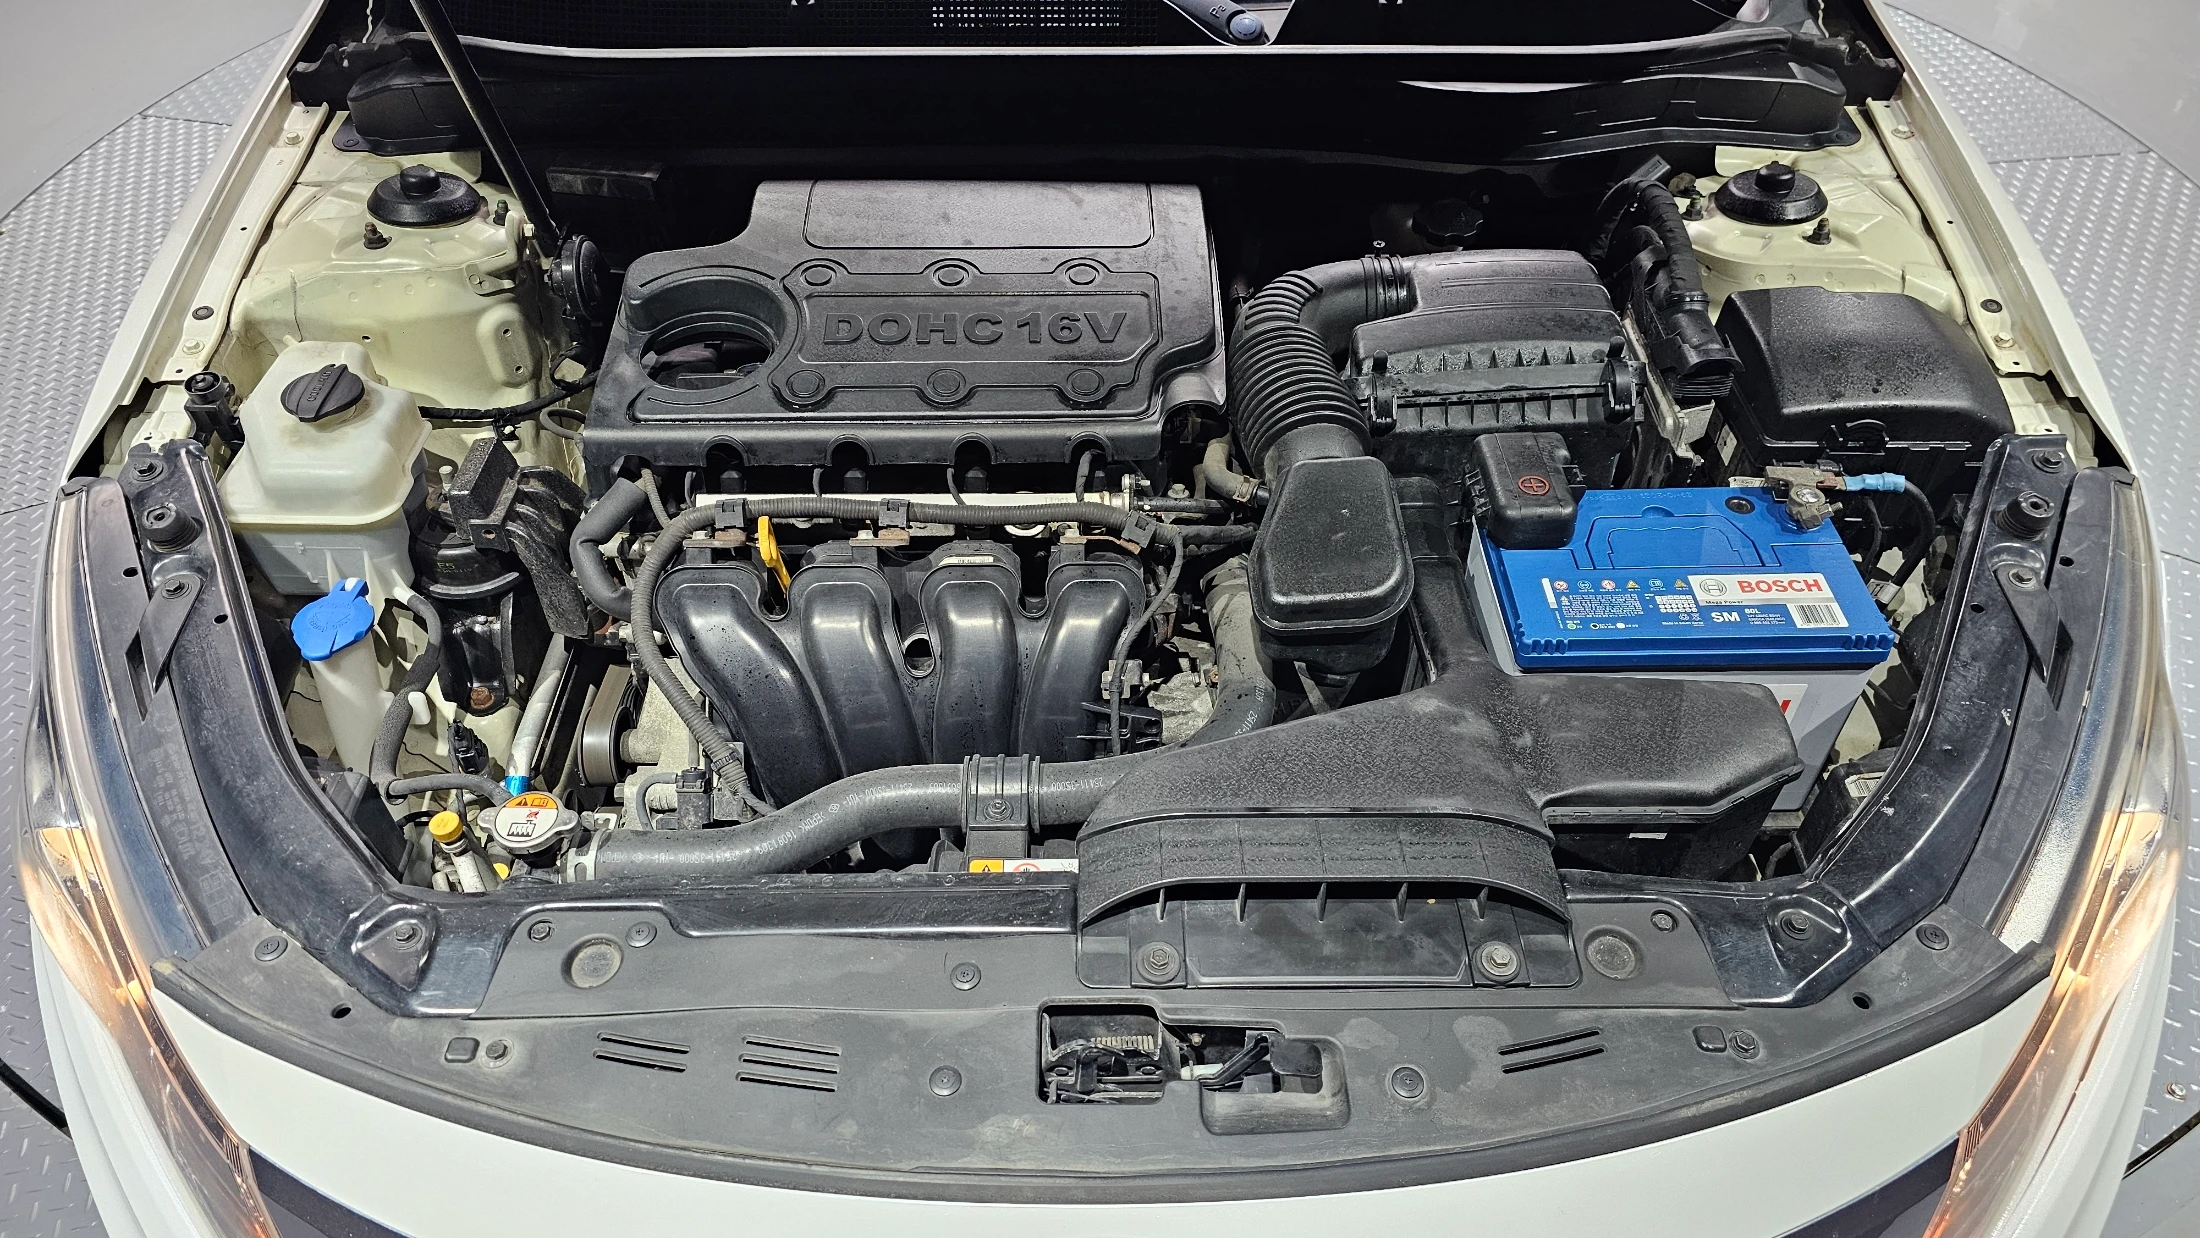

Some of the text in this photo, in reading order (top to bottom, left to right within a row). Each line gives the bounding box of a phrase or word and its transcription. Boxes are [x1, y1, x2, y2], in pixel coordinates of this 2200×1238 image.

[823, 311, 1127, 345] DOHC 16V
[1737, 579, 1823, 593] BOSCH
[1711, 611, 1741, 622] SM
